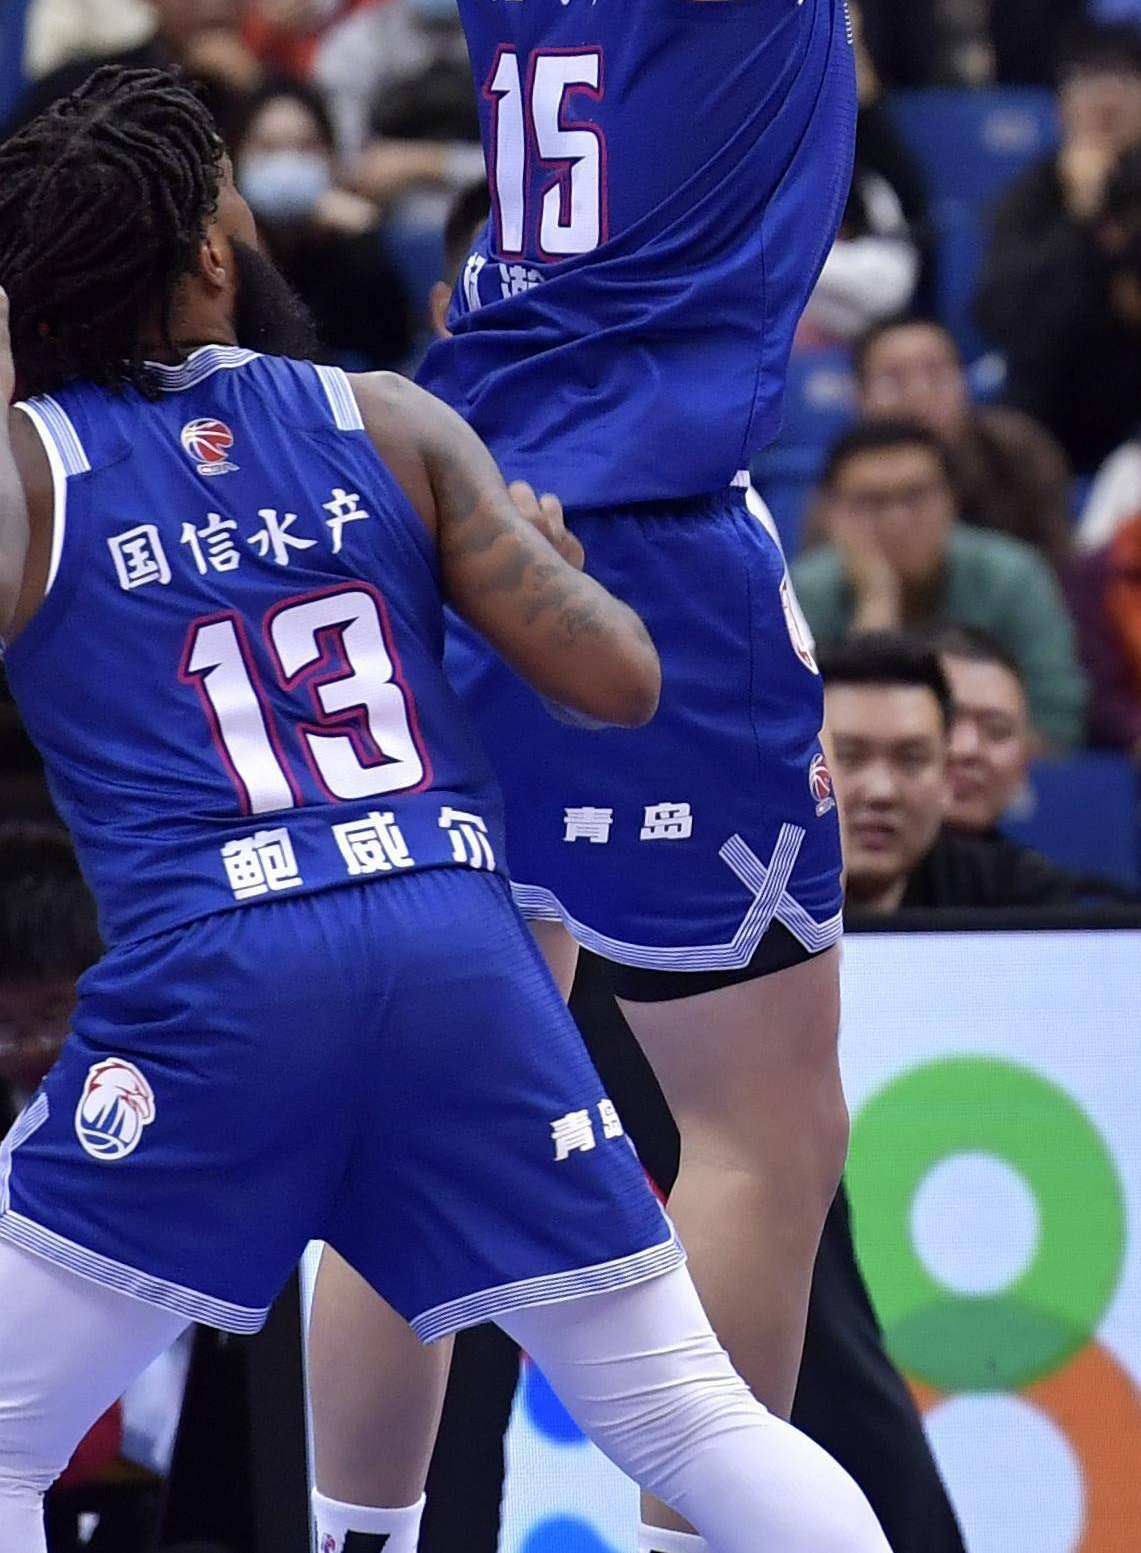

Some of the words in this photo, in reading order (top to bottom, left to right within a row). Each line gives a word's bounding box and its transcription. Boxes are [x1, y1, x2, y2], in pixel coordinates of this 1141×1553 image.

[484, 43, 608, 262] 15
[106, 487, 371, 591] 国信水产
[178, 580, 434, 817] 13
[219, 805, 497, 901] 鲍威尔
[562, 801, 694, 844] 青岛
